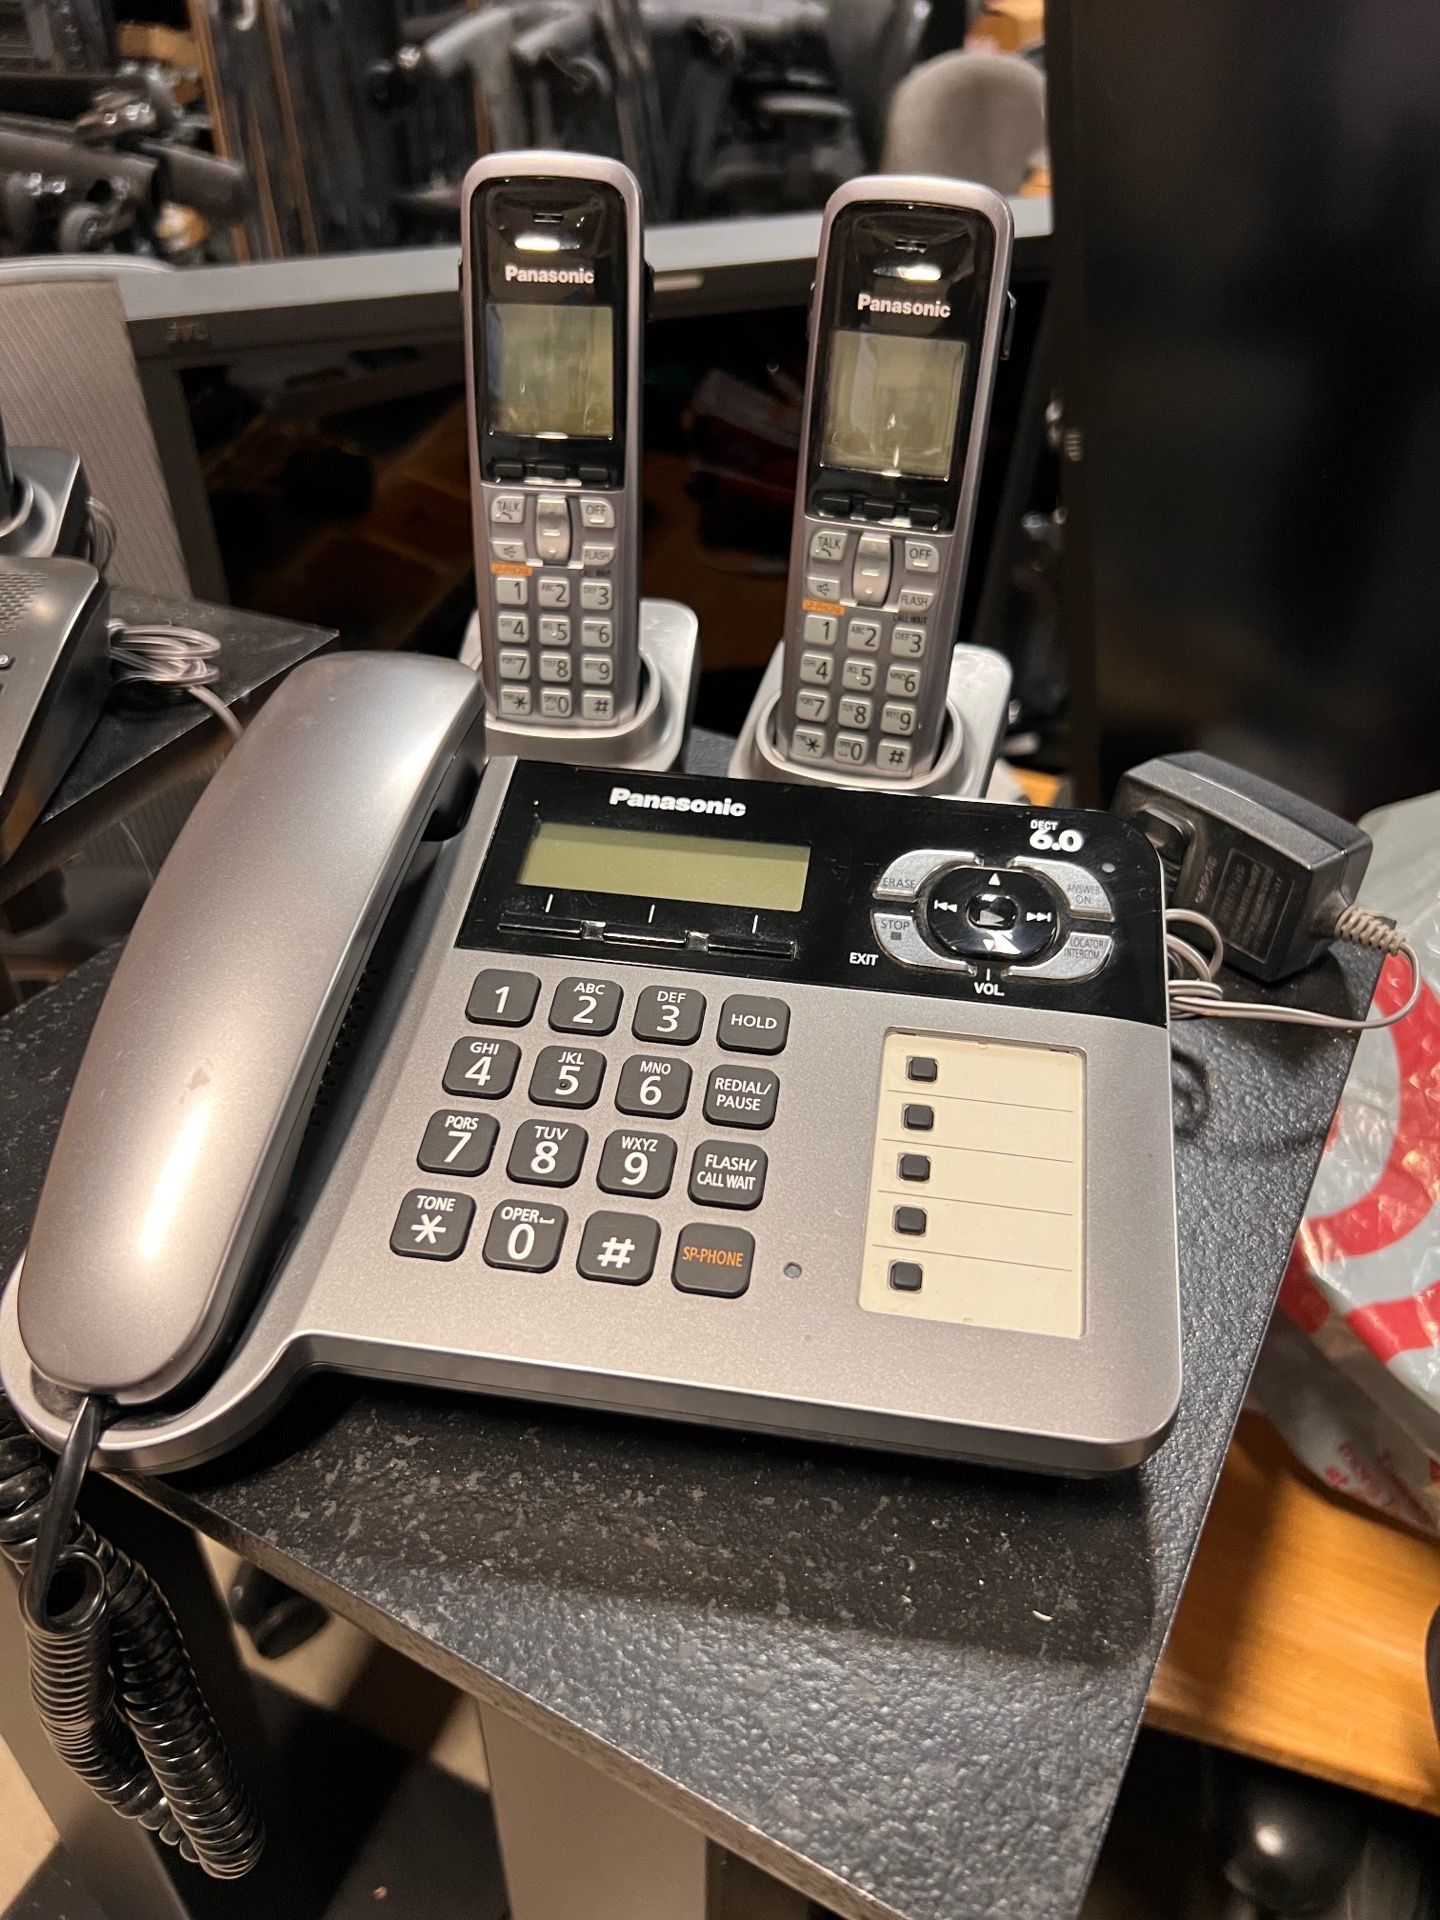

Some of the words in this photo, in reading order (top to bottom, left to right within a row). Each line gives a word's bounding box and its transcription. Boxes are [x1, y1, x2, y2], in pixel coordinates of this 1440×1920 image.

[504, 264, 595, 285] Panasonic
[857, 293, 951, 318] Panasonic
[585, 504, 607, 516] OFF
[818, 535, 842, 550] TALK
[909, 548, 932, 561] OFF
[514, 582, 521, 600] 1
[555, 584, 567, 602] 2
[597, 587, 609, 606] 3
[900, 592, 928, 606] FLASH
[513, 621, 525, 639] 4
[556, 624, 568, 641] 5
[598, 626, 610, 644] 6
[823, 621, 830, 640] 1
[864, 628, 877, 647] 2
[909, 634, 922, 653] 3
[517, 657, 527, 676] 7
[557, 660, 569, 678] 8
[599, 663, 610, 681] 9
[816, 661, 828, 680] 4
[861, 667, 872, 686] 5
[904, 674, 916, 693] 6
[558, 696, 569, 714] 0
[814, 699, 825, 717] 7
[854, 705, 867, 724] 8
[900, 712, 911, 731] 9
[851, 743, 862, 761] 0
[609, 787, 747, 817] Panasonic
[1030, 819, 1058, 831] DECT
[1029, 829, 1084, 852] 6.0
[883, 878, 916, 889] ERASE
[1066, 883, 1102, 895] ANSWER
[1075, 894, 1091, 905] ON
[880, 919, 910, 931] STOP
[1069, 937, 1104, 950] LOCATOR
[849, 952, 878, 966] EXIT
[1064, 948, 1100, 960] INTERCOM
[573, 982, 605, 996] ABC
[656, 990, 686, 1003] DEF
[495, 985, 511, 1014] 1
[572, 996, 595, 1024] 2
[656, 1004, 680, 1033] 3
[730, 1013, 777, 1030] HOLD
[469, 1041, 499, 1055] GHI
[557, 1051, 585, 1065] JKL
[464, 1056, 492, 1086] 4
[639, 1061, 671, 1075] MNO
[554, 1065, 580, 1096] 5
[714, 1076, 772, 1095] REDIAL/
[639, 1075, 662, 1106] 6
[715, 1093, 762, 1111] PAUSE
[444, 1114, 479, 1130] PQRS
[534, 1126, 569, 1141] TUV
[444, 1131, 472, 1163] 7
[621, 1136, 658, 1152] WXYZ
[530, 1141, 559, 1174] 8
[704, 1153, 758, 1172] FLASH/
[621, 1151, 649, 1186] 9
[696, 1171, 724, 1188] CALL
[727, 1174, 756, 1191] WAIT
[416, 1195, 456, 1211] TONE
[507, 1223, 535, 1260] 0
[597, 1237, 635, 1268] #
[682, 1245, 744, 1268] SP-PHONE
